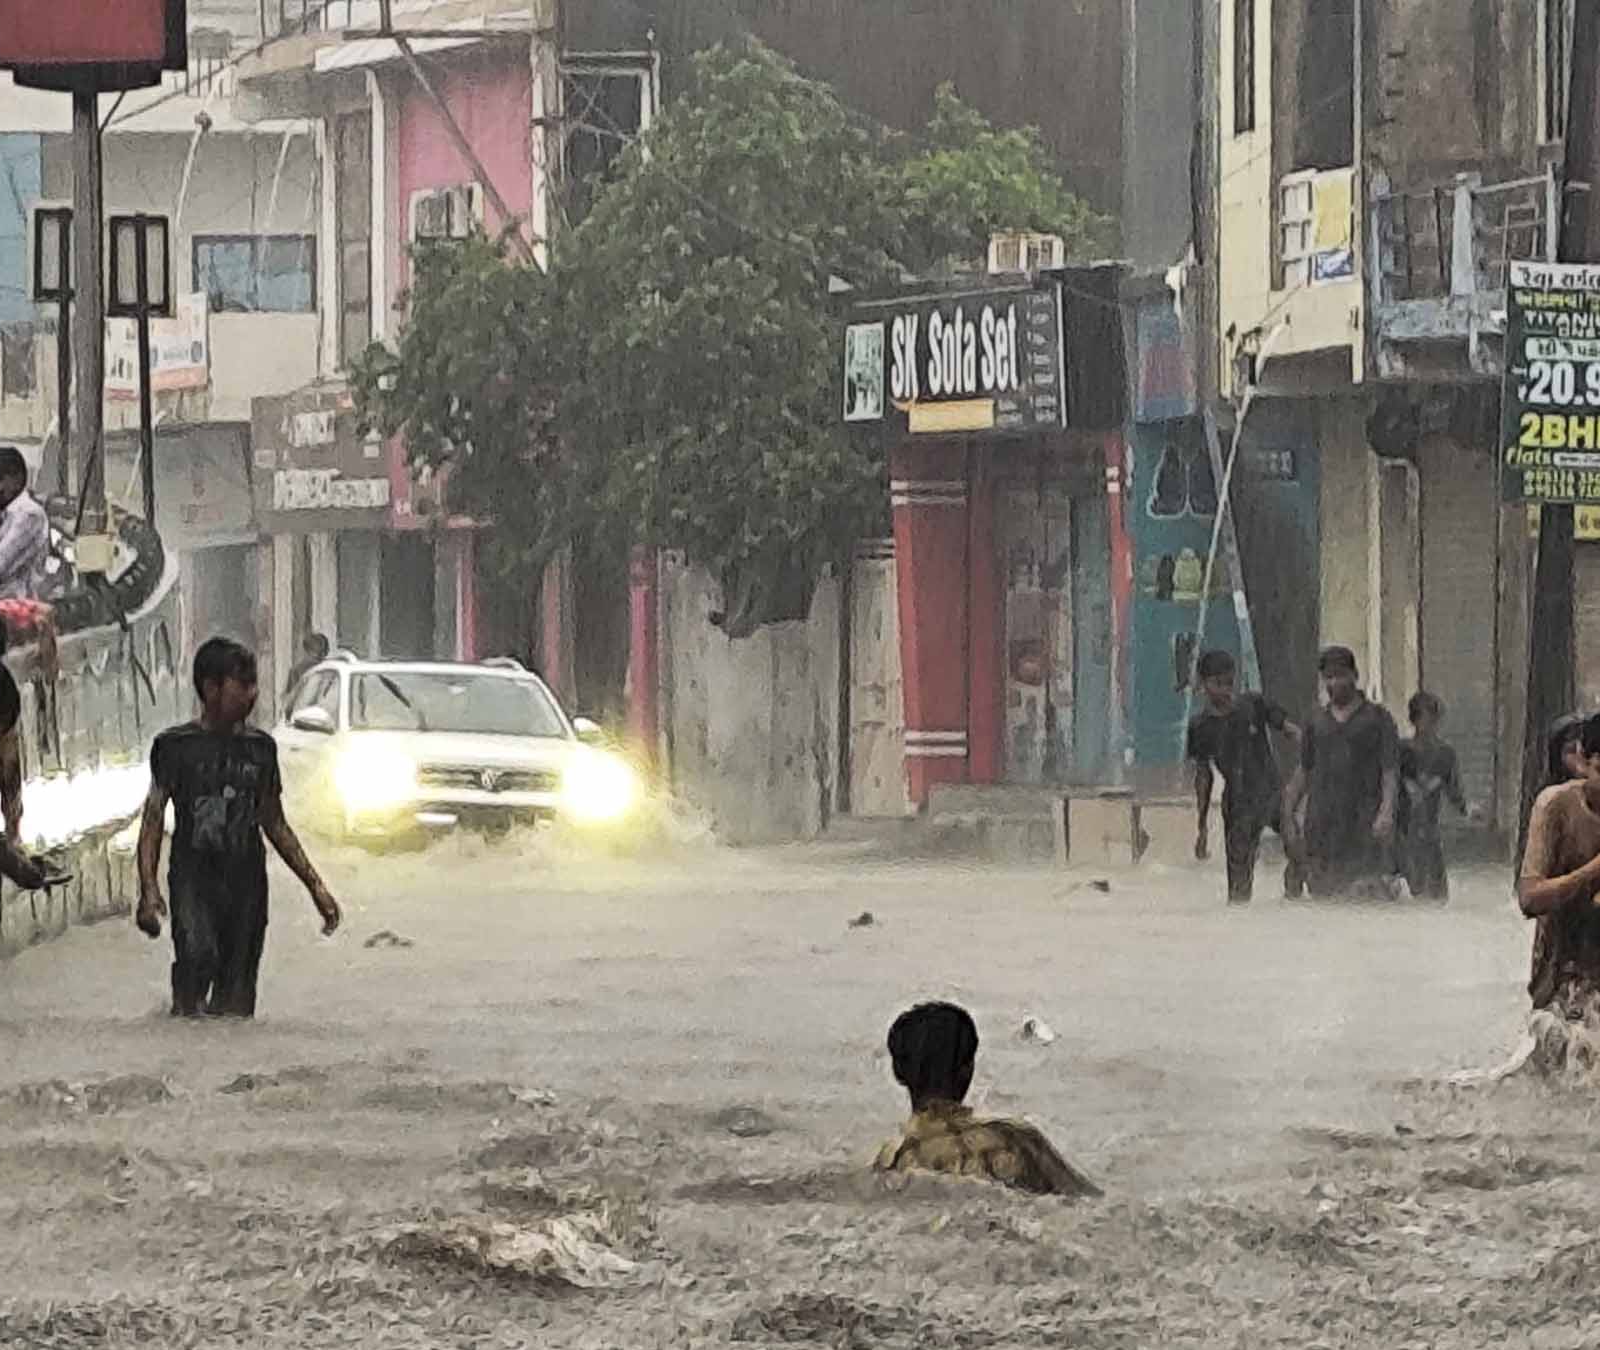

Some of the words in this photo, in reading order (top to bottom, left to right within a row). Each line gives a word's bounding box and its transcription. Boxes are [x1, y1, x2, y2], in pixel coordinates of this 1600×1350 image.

[891, 313, 919, 399] SK
[928, 305, 977, 396] Sofa
[981, 303, 1018, 392] Set
